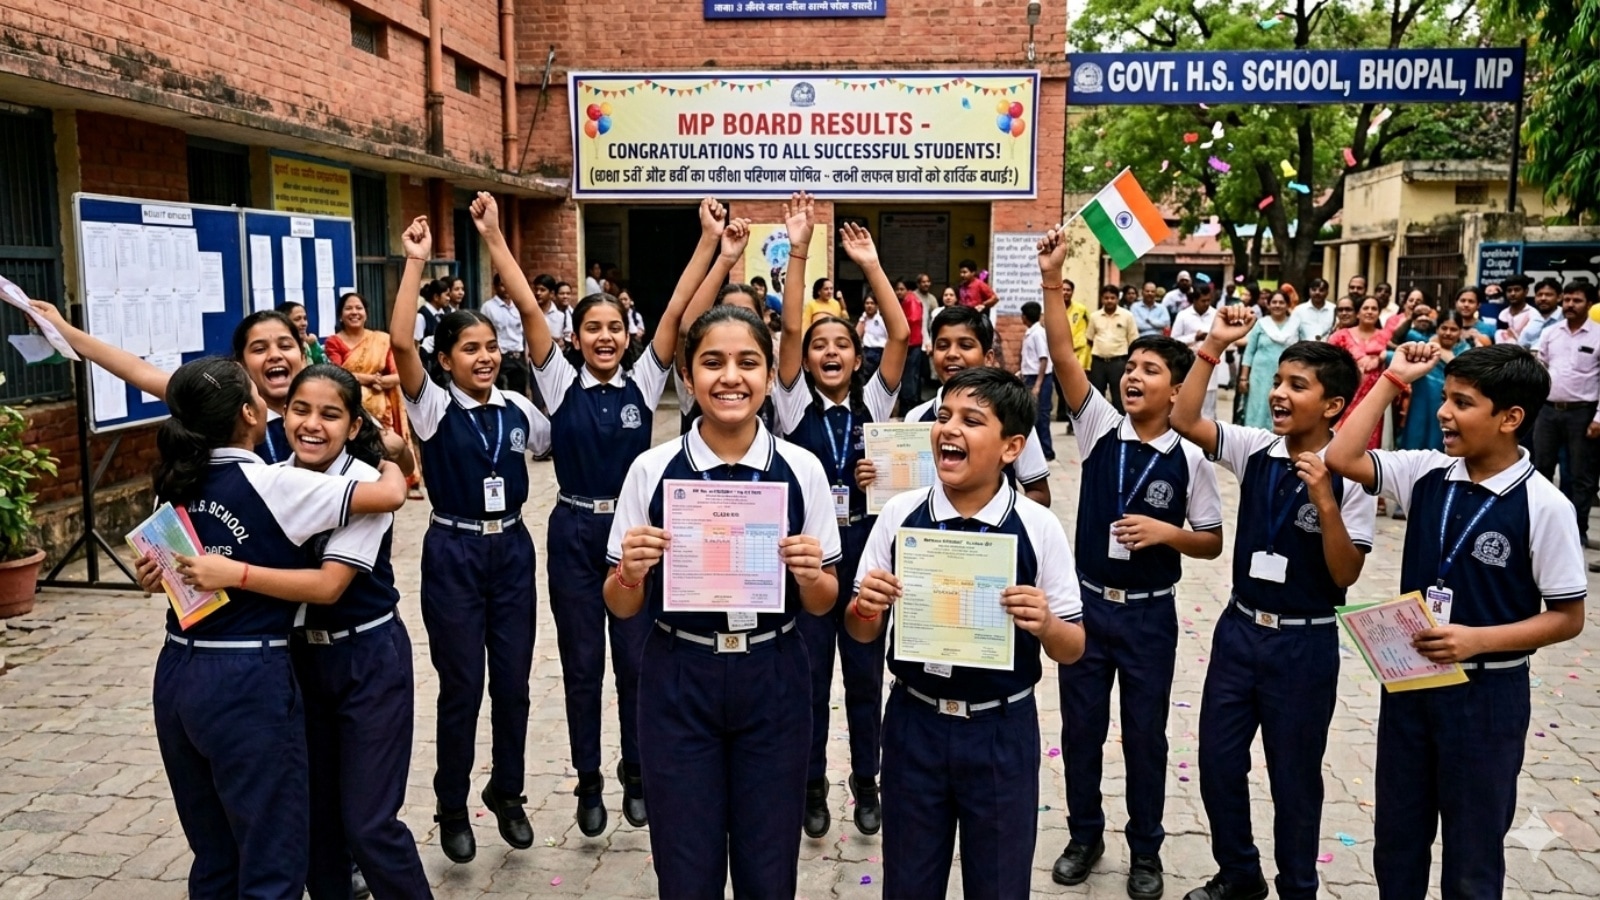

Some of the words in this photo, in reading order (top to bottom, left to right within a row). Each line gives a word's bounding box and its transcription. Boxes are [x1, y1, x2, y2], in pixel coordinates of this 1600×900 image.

[1107, 61, 1179, 92] GOVT.
[1186, 61, 1234, 92] H.S.
[1242, 60, 1351, 97] SCHOOL,
[1359, 59, 1467, 96] BHOPAL,
[1475, 58, 1514, 89] MP
[678, 113, 715, 135] MP
[723, 113, 802, 135] BOARD
[811, 112, 913, 135] RESULTS
[608, 143, 754, 160] CONGRATULATIONS
[758, 143, 778, 159] TO
[782, 143, 810, 159] ALL
[814, 143, 910, 159] SUCCESSFUL
[914, 142, 1001, 159] STUDENTS!
[690, 170, 706, 182] का
[925, 165, 942, 183] को
